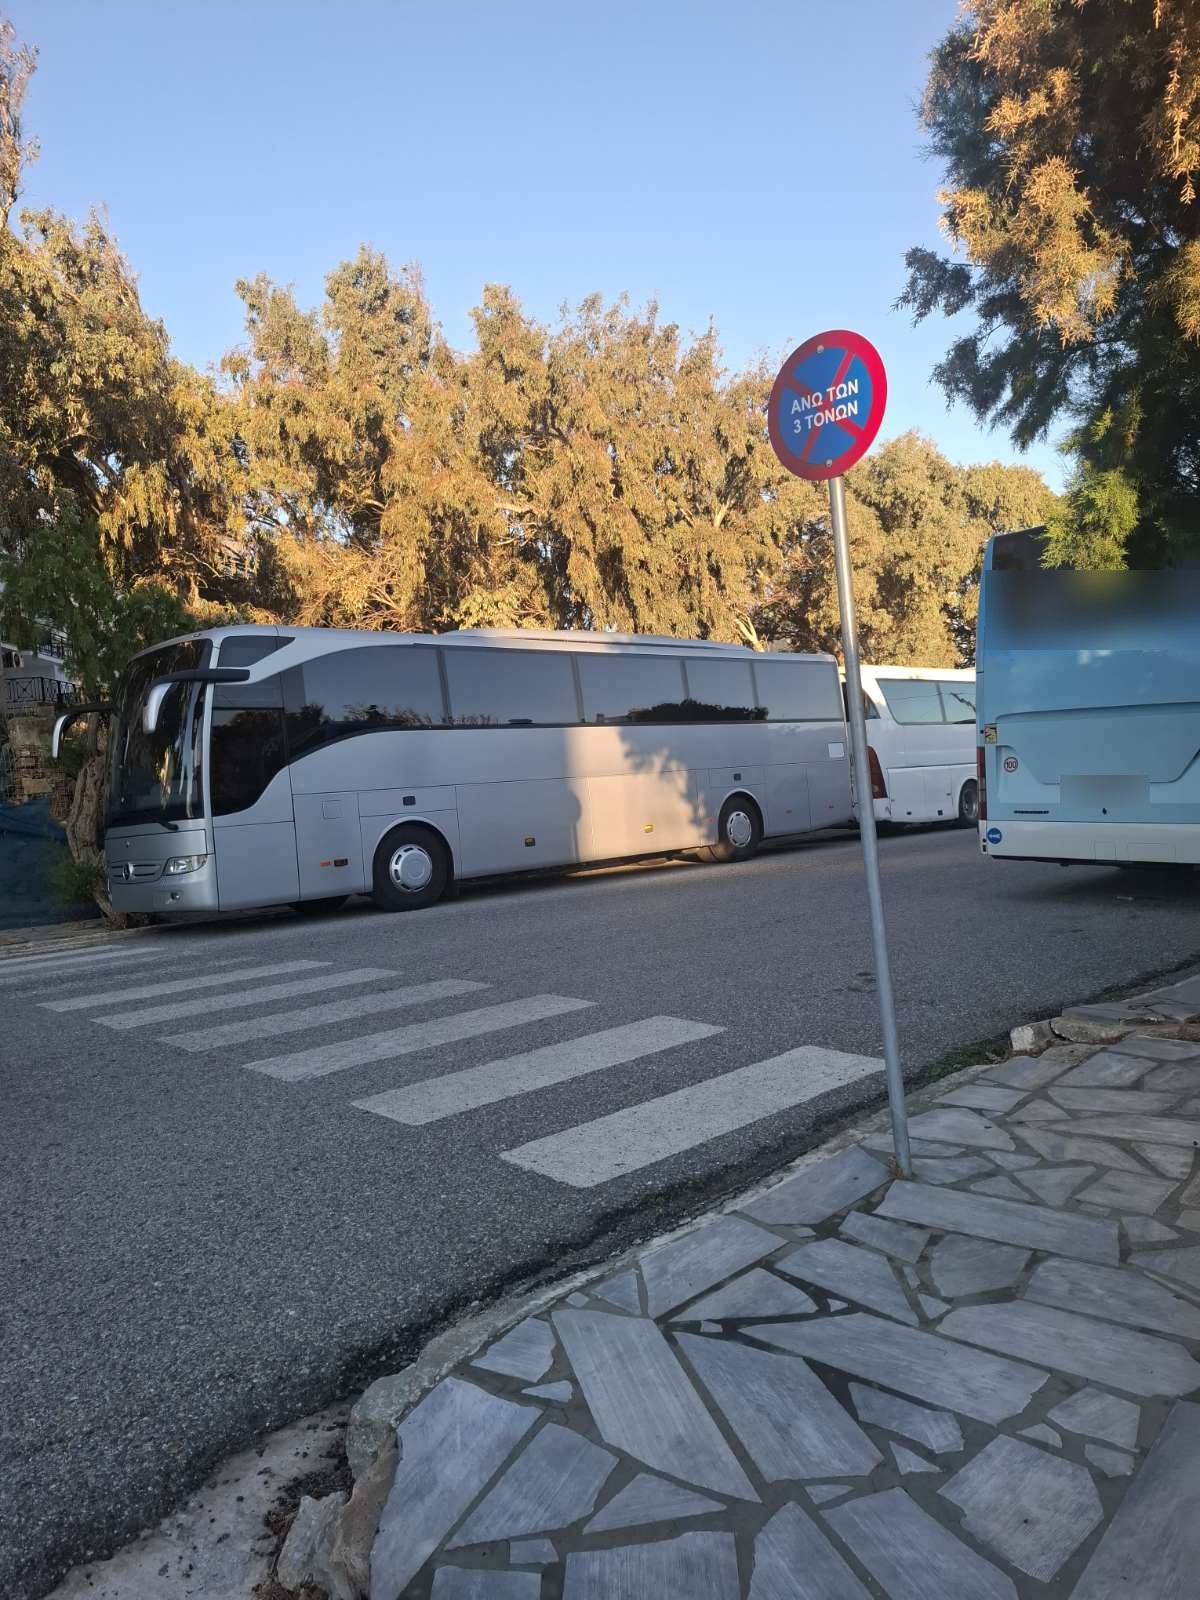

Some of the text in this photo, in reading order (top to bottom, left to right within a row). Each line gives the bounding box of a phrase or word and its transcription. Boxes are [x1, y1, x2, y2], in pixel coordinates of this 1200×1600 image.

[791, 378, 859, 414] ΑΝΩ ΤΩΝ
[794, 400, 858, 434] 3 ΤΟΝΩΝ
[1005, 761, 1017, 769] 100
